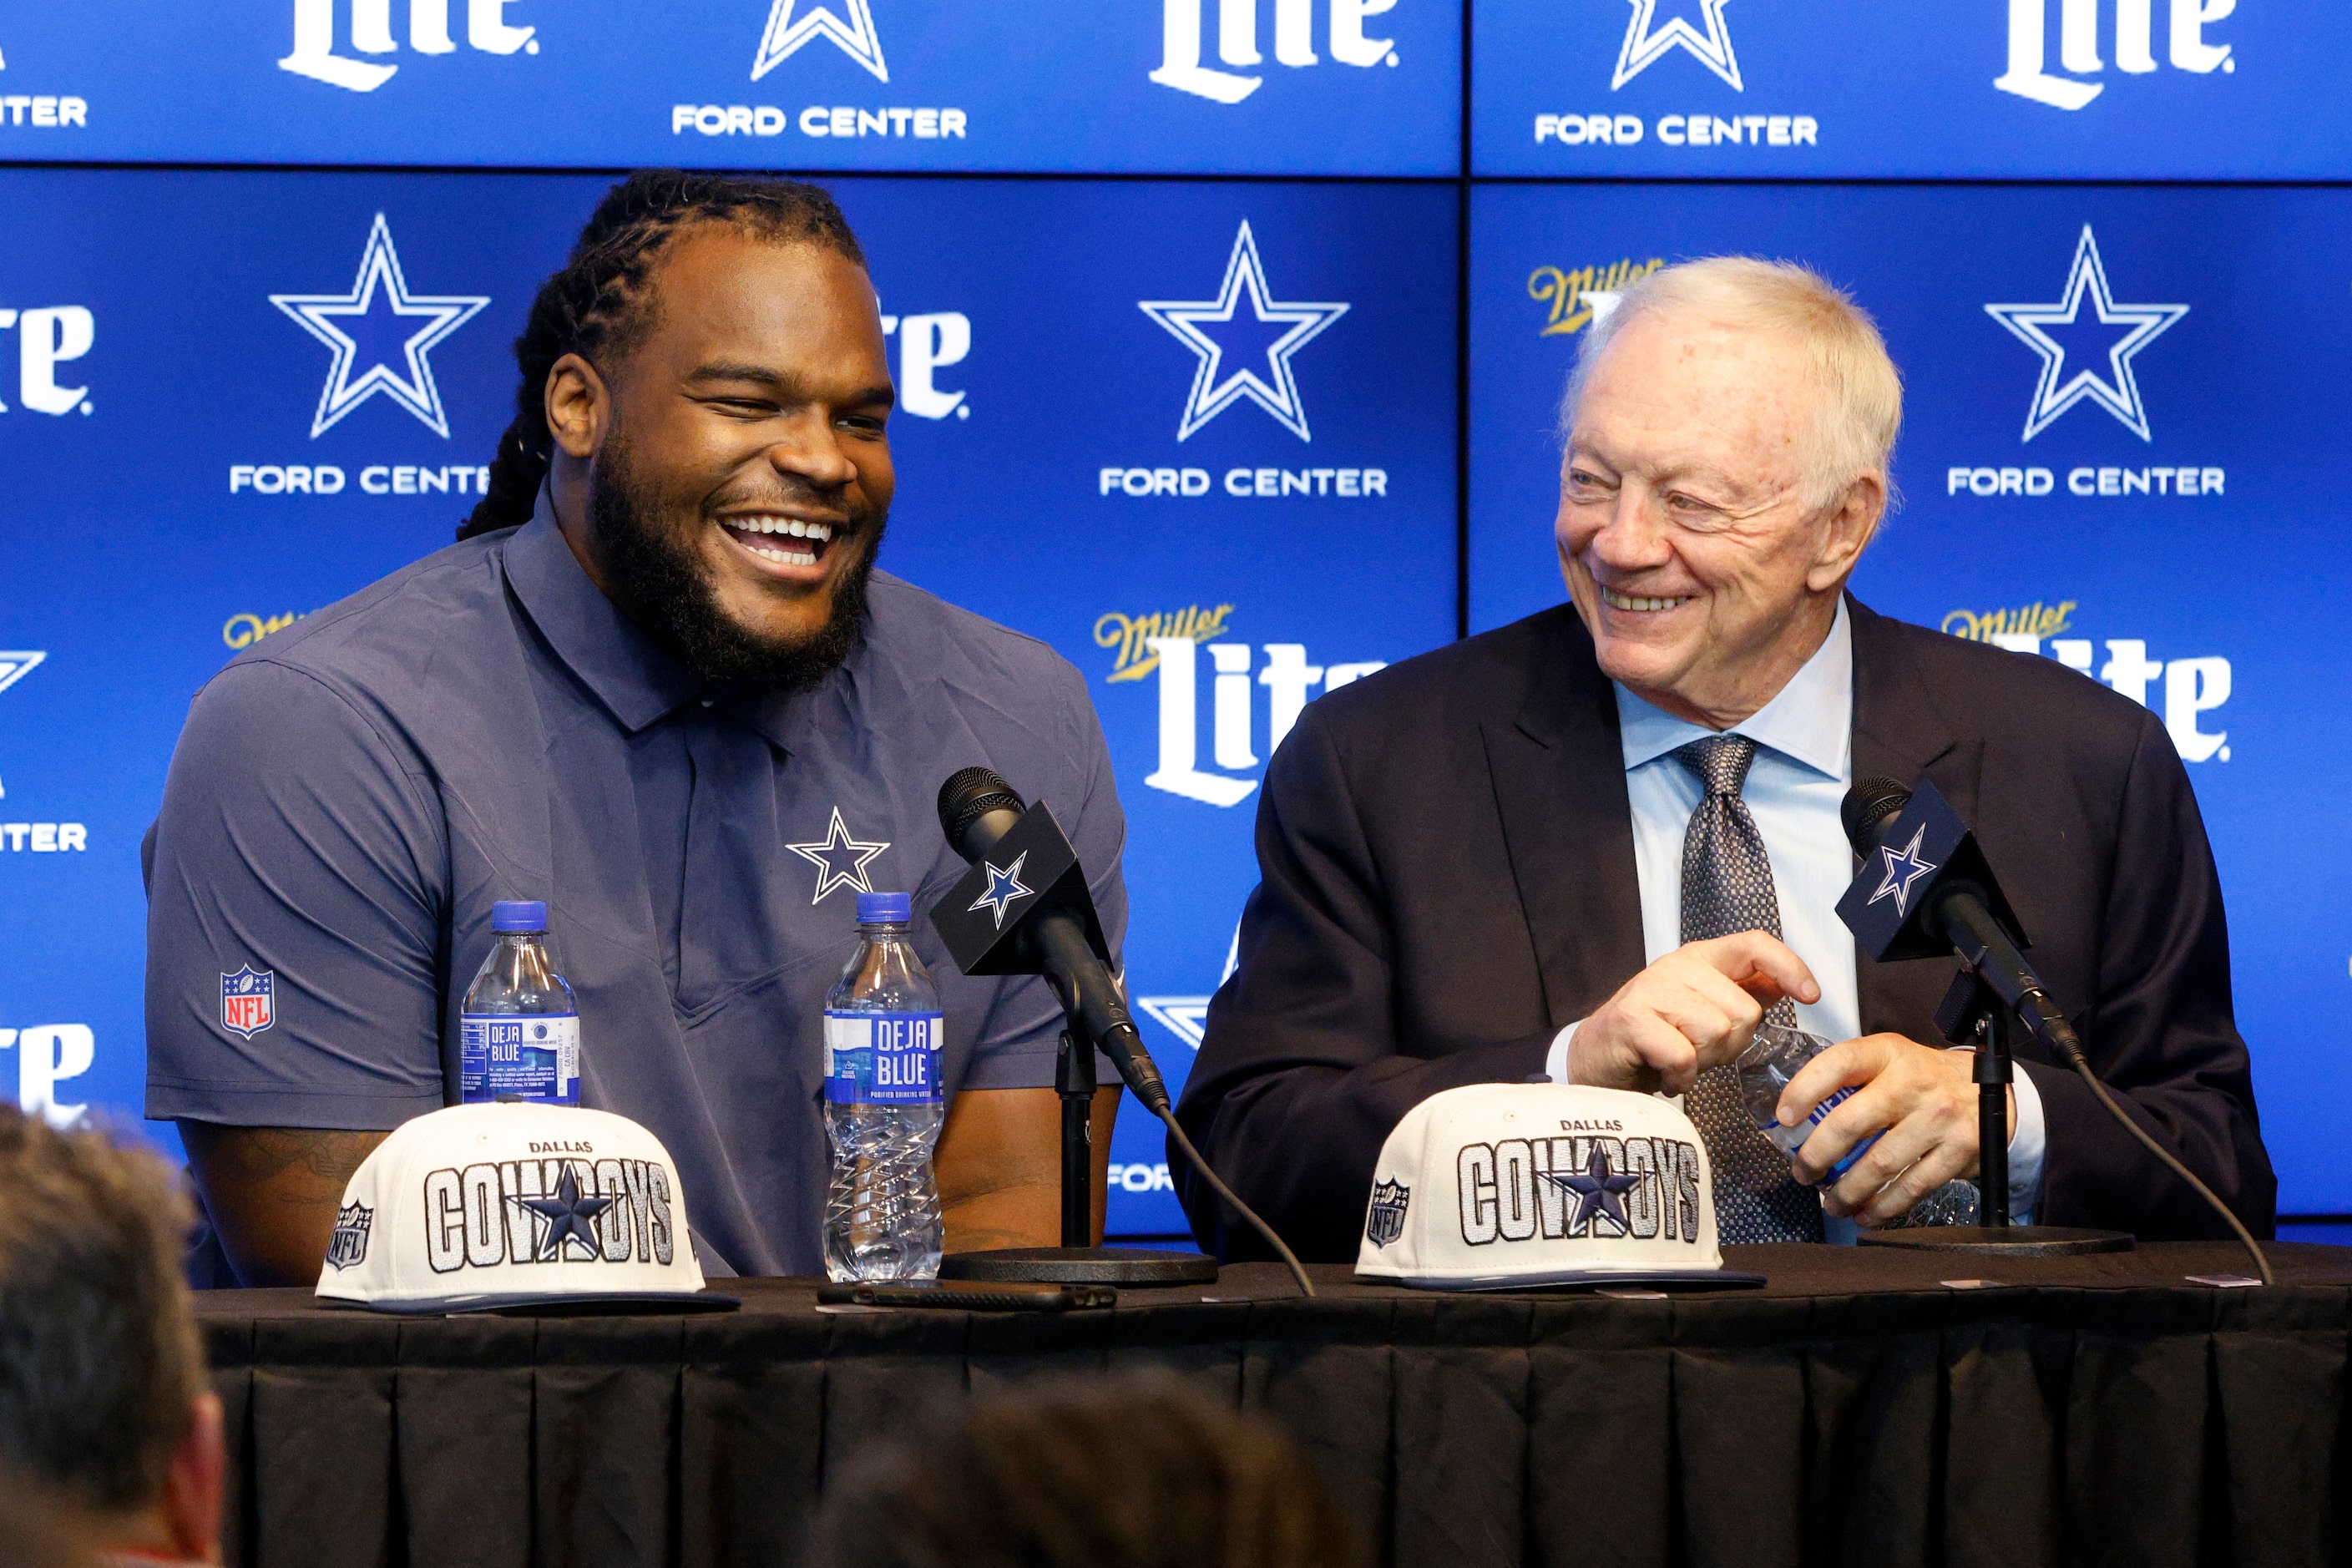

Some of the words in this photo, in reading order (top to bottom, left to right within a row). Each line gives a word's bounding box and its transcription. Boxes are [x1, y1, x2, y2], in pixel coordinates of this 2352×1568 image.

[672, 105, 786, 135] FORD
[799, 106, 966, 138] CENTER
[1535, 114, 1643, 144] FORD
[1657, 115, 1818, 145] CENTER
[230, 466, 345, 493] FORD
[360, 467, 490, 494] CENTE
[1100, 468, 1210, 496] FORD
[1225, 469, 1386, 496] CENTER
[1948, 468, 2053, 496] FORD
[2068, 468, 2224, 495] CENTER
[1093, 603, 1235, 683] Miller
[1145, 636, 1389, 807] Lit
[227, 997, 269, 1029] NFL
[492, 1026, 519, 1044] DEJA
[878, 1020, 927, 1052] DEJA
[492, 1044, 519, 1062] BLUE
[878, 1053, 927, 1085] BLUE
[1560, 1120, 1623, 1131] DALLAS
[529, 1141, 593, 1153] DALLAS
[1370, 1206, 1399, 1240] NFL
[330, 1231, 361, 1262] NFL
